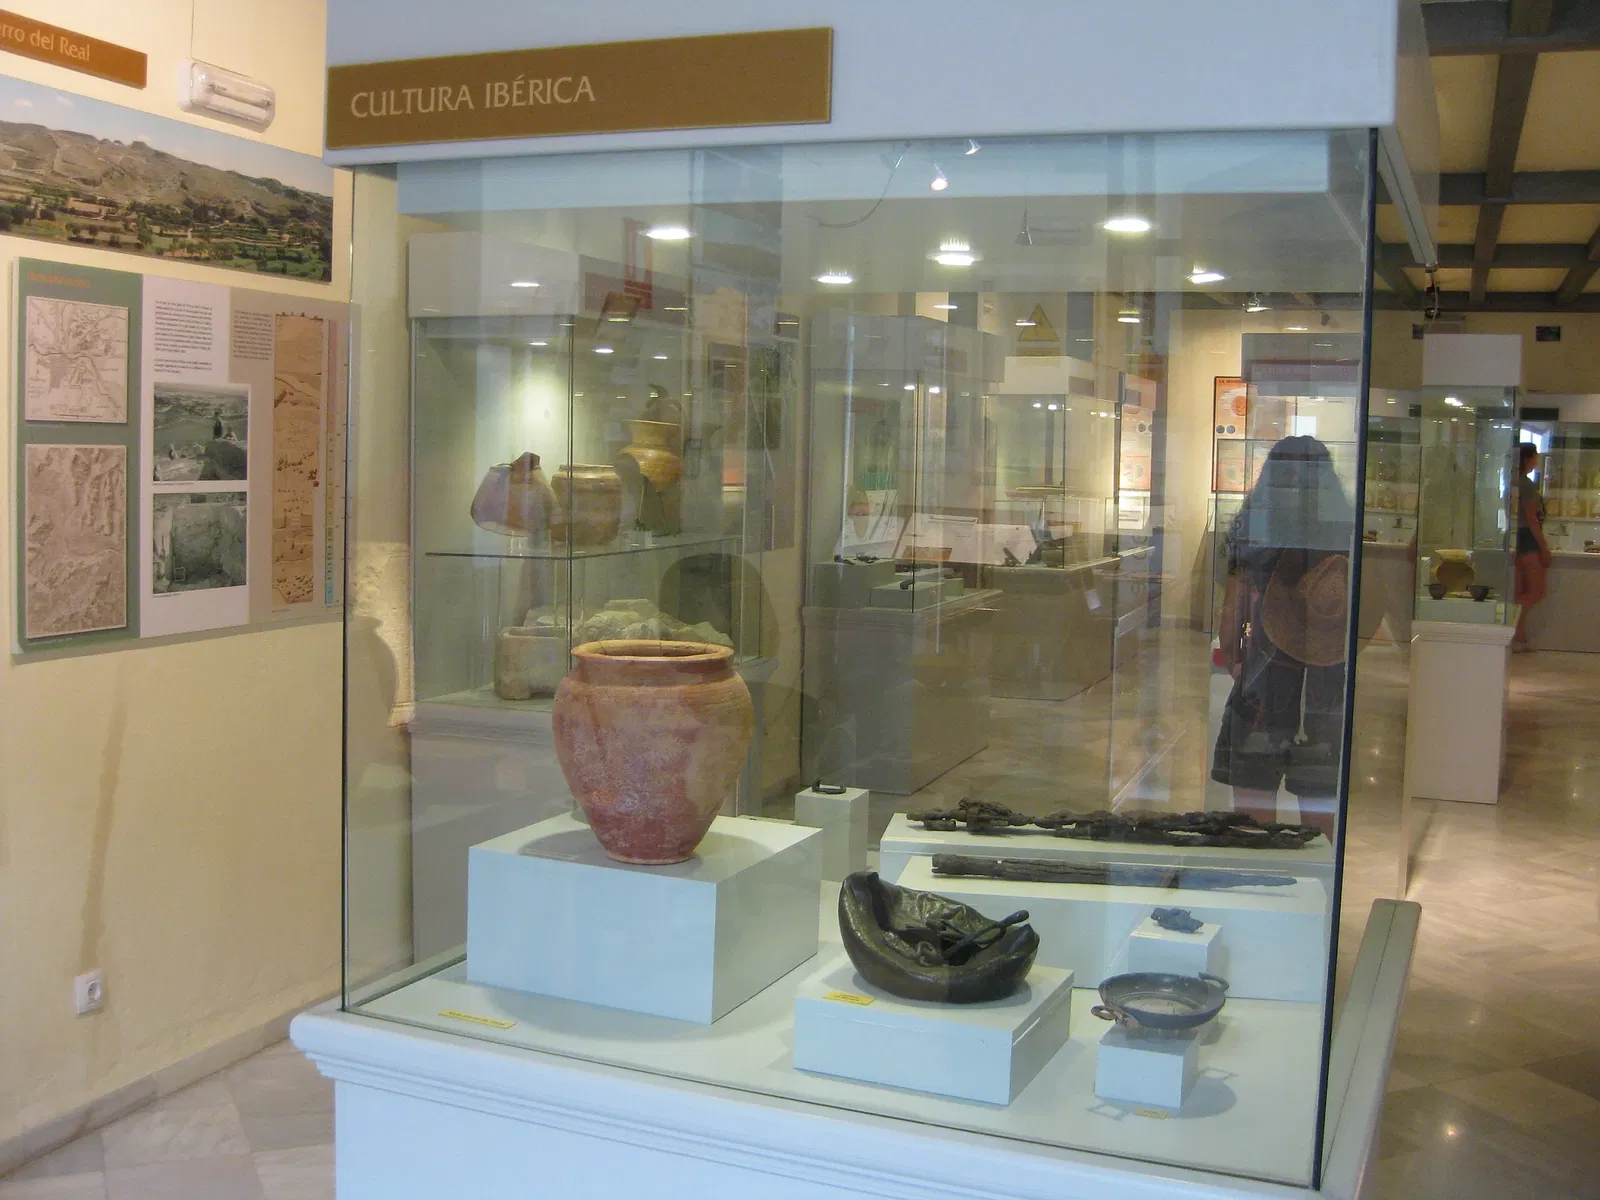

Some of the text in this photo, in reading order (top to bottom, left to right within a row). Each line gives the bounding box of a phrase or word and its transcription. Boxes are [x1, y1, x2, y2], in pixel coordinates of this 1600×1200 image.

[0, 23, 90, 61] rro del Real
[351, 74, 597, 118] CULTURA IBÉRICA
